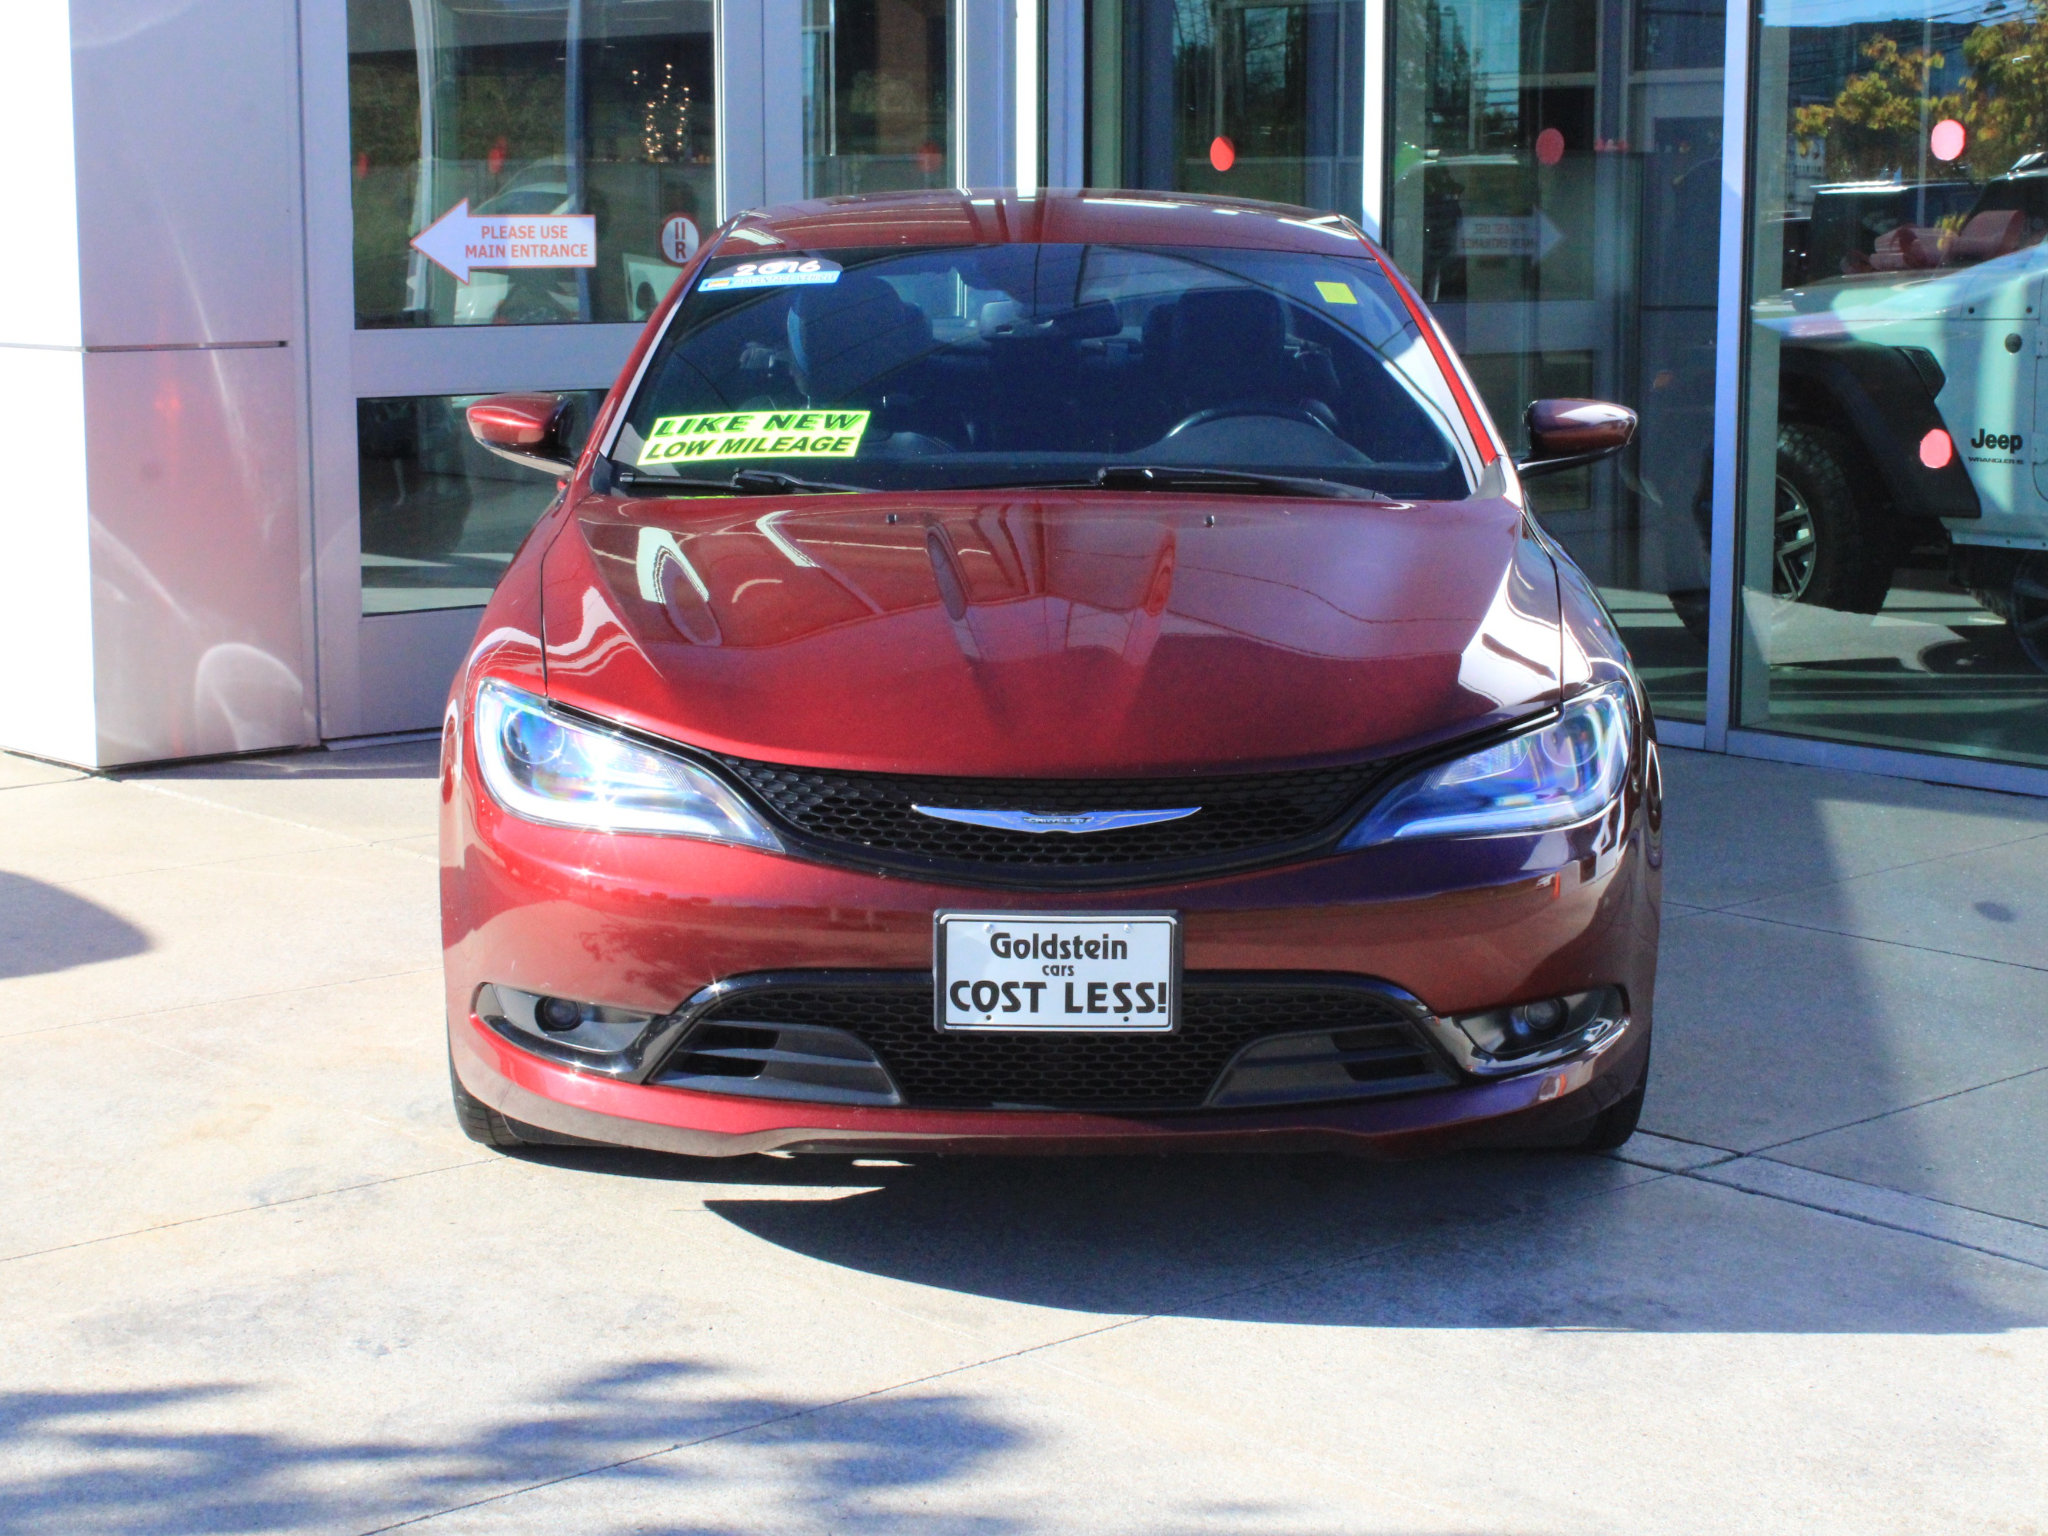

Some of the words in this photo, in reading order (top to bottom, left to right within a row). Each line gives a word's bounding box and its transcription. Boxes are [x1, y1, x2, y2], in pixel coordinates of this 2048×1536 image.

[481, 225, 535, 239] PLEASE
[541, 225, 568, 239] USE
[465, 244, 506, 258] MAIN
[511, 243, 588, 258] ENTRANCE
[733, 260, 821, 277] 2016
[654, 415, 754, 437] LIKE
[762, 413, 864, 432] NEW
[645, 439, 718, 460] LOW
[716, 436, 854, 455] MILEAGE
[1970, 428, 2023, 454] Jeep
[990, 932, 1128, 960] Goldstein
[1042, 964, 1074, 977] cars
[949, 980, 1047, 1013] COST
[1064, 981, 1167, 1014] LESS!
